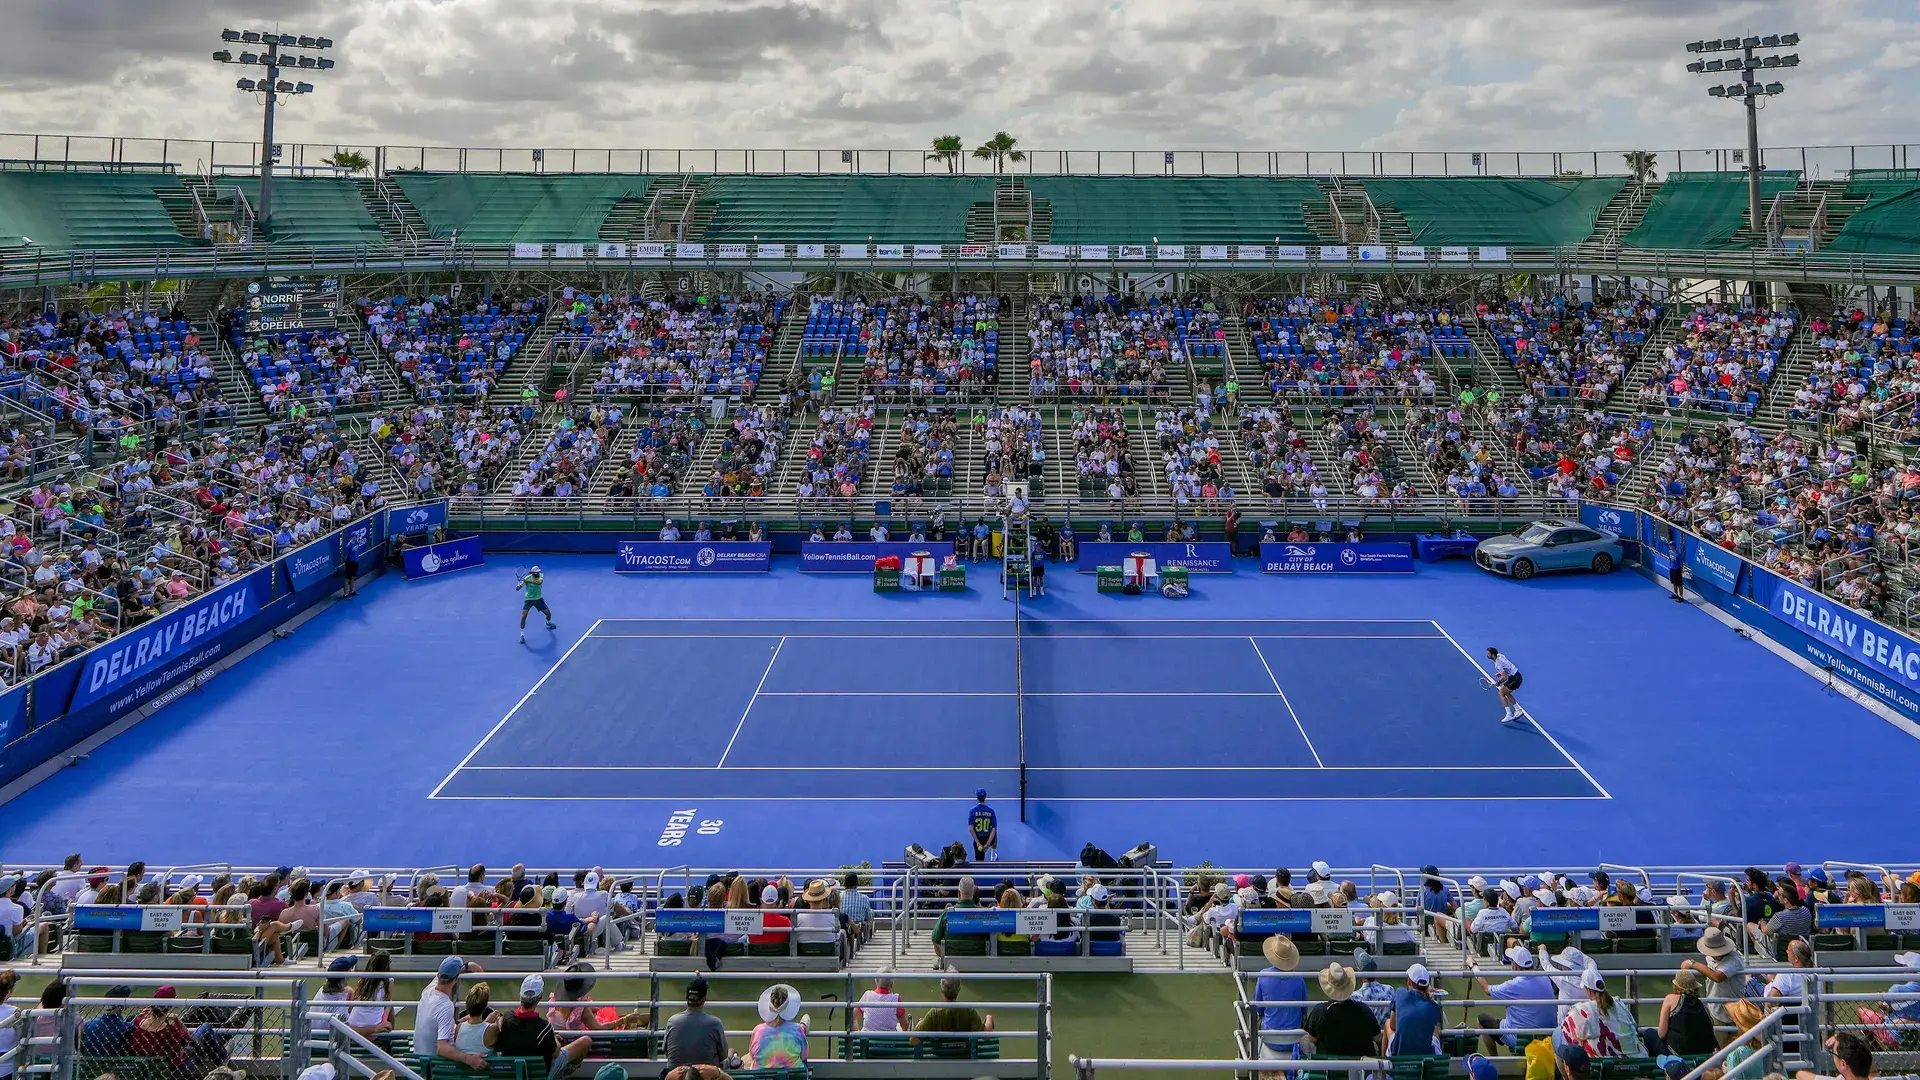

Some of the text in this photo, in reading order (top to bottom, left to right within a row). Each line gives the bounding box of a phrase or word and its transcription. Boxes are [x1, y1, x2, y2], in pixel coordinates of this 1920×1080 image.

[680, 279, 688, 290] G
[908, 279, 916, 290] H
[1339, 281, 1345, 291] J
[453, 286, 460, 296] F
[263, 294, 303, 303] NORRIE
[261, 321, 304, 330] OPELKA
[803, 553, 876, 561] YellowTennisBall.com
[1186, 544, 1199, 558] R
[625, 553, 691, 565] VITACOST.COM
[1167, 559, 1218, 567] RENAISSANCE
[1267, 563, 1334, 571] DELRAY BEACH
[1782, 590, 1857, 647] DELRAY
[89, 588, 247, 694] DELRAY BEACH
[109, 643, 221, 714] www.YellowTennisBall.com
[1807, 644, 1918, 713] www.YellowTennisBall.com
[151, 684, 189, 709] CELEBRATING
[197, 669, 215, 682] YEARS
[657, 808, 697, 847] YEARS
[696, 819, 724, 835] 30
[975, 817, 990, 832] 30
